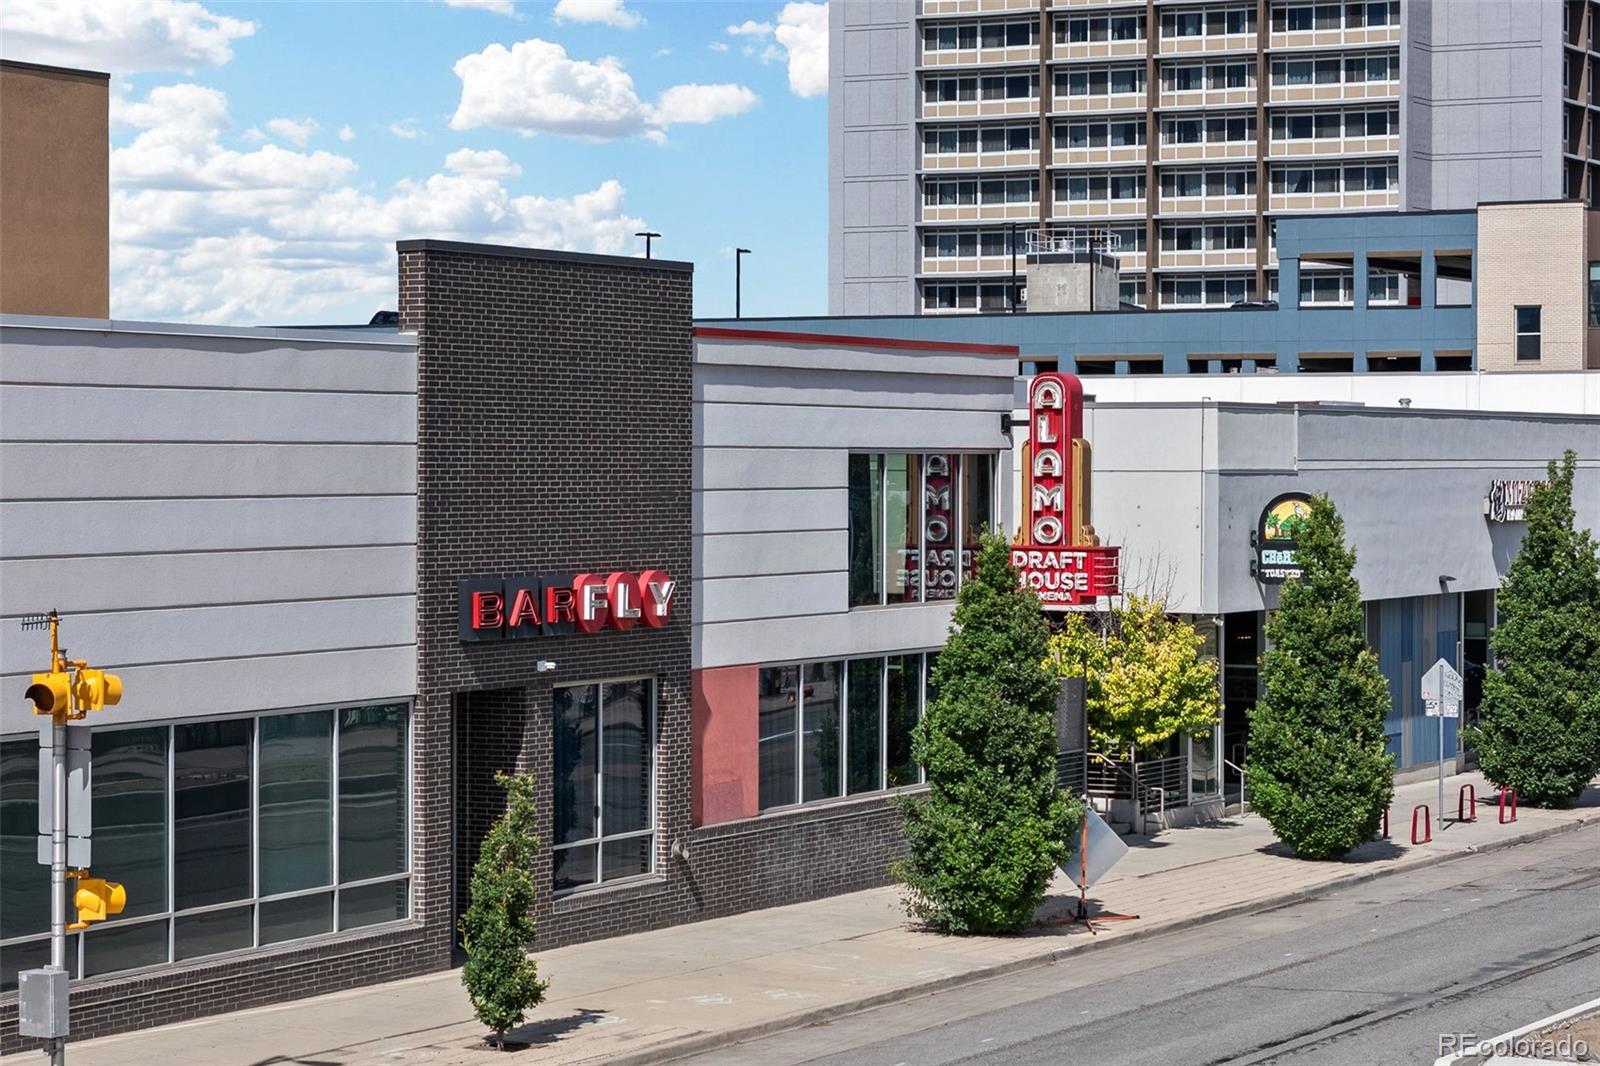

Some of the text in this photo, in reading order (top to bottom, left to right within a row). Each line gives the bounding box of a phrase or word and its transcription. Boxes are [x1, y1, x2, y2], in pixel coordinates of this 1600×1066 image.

[1034, 381, 1064, 544] ALAMO
[1012, 551, 1087, 569] DRAFT
[472, 581, 676, 629] BARFLY
